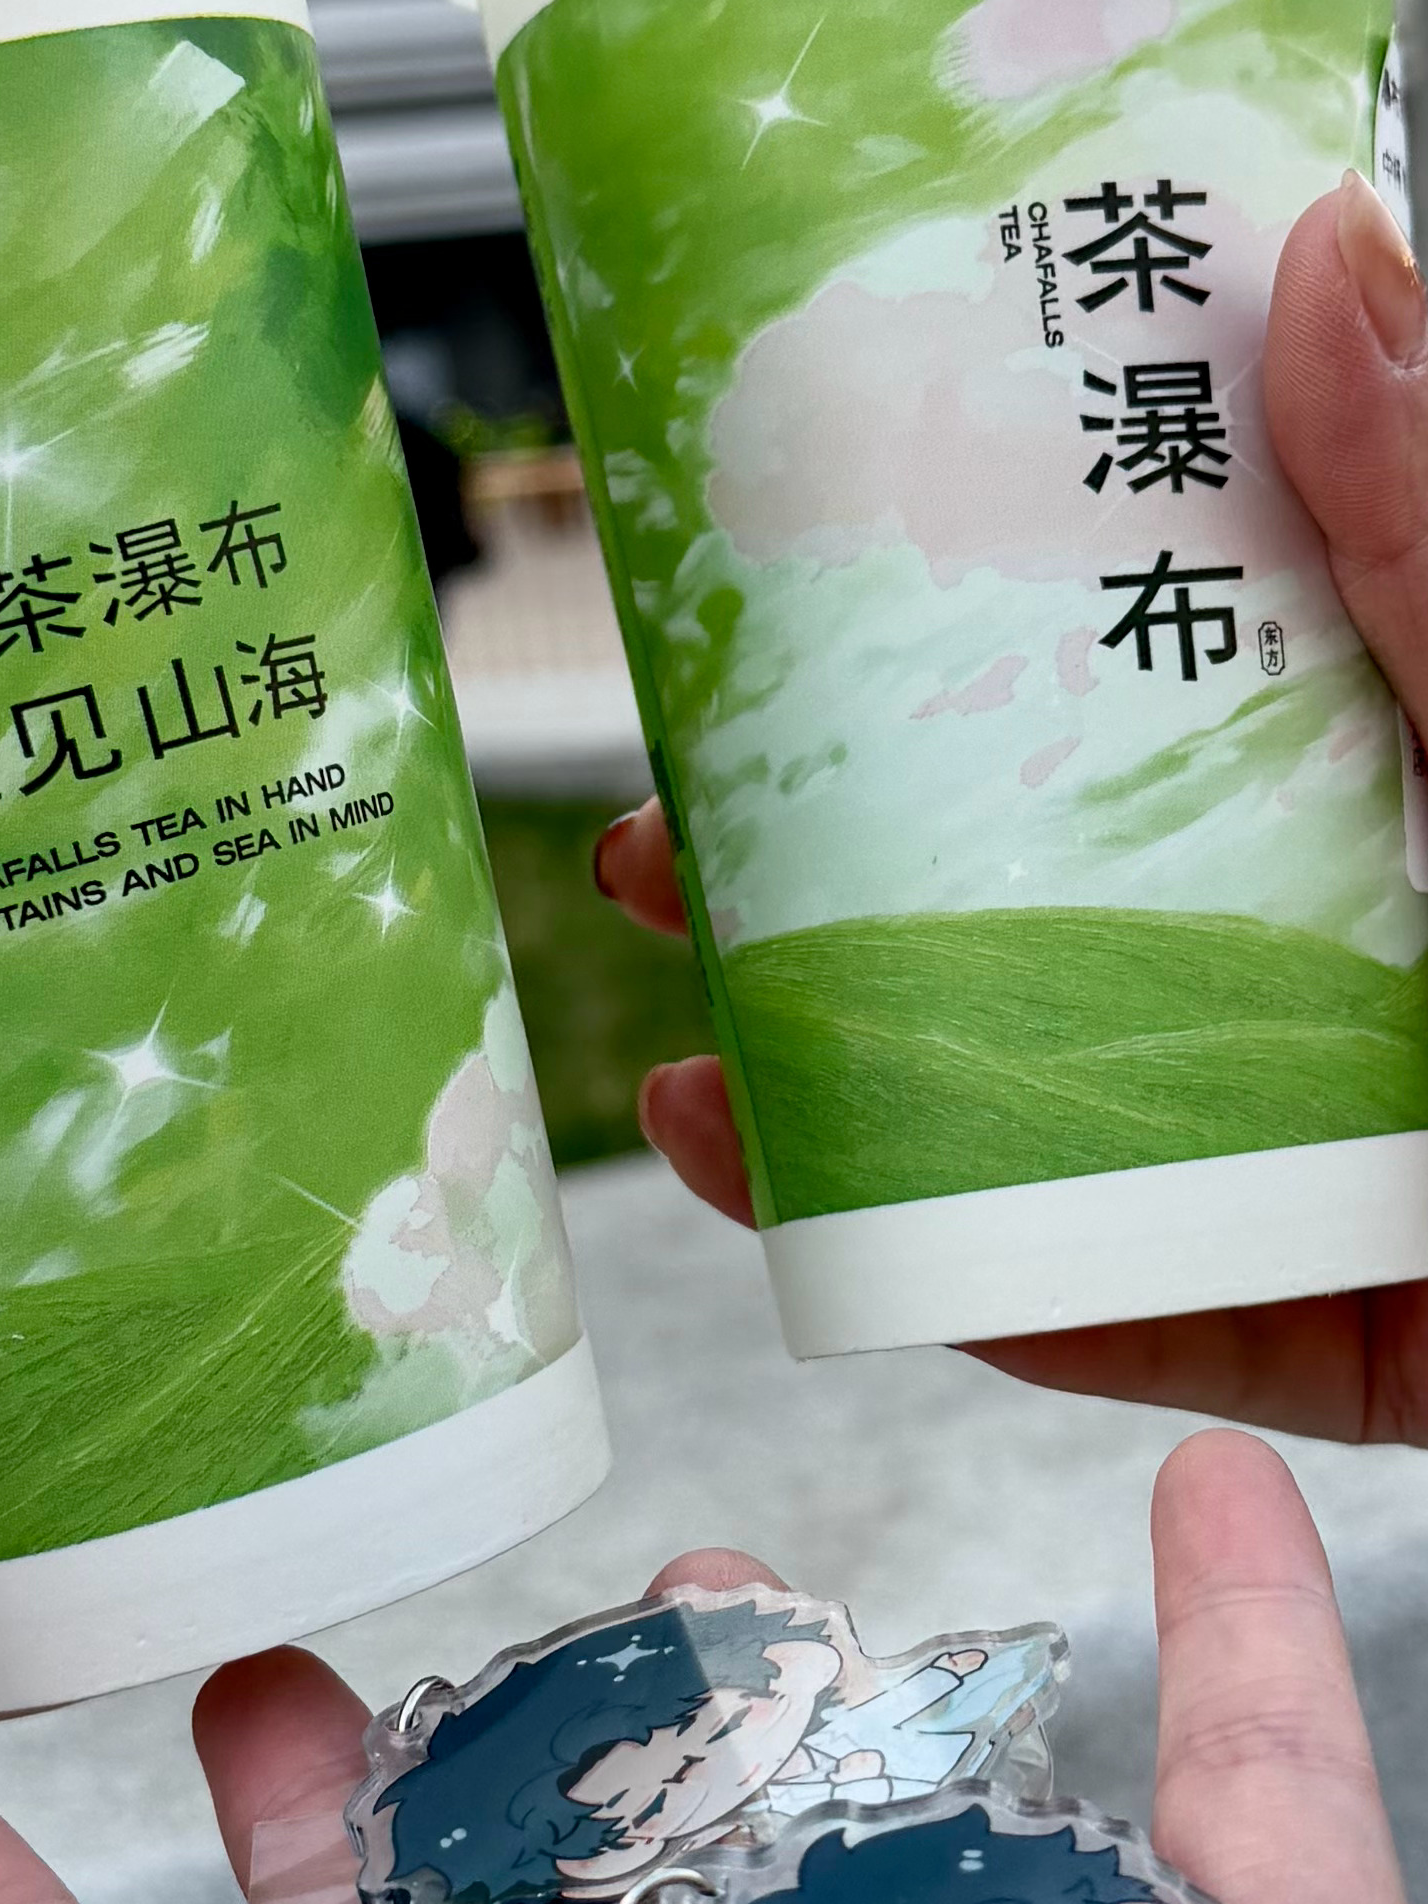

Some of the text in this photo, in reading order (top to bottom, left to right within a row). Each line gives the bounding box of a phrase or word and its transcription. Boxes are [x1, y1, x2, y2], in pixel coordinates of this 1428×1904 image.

[999, 204, 1022, 263] TEA
[1028, 201, 1064, 349] CHAFALLS
[1062, 179, 1244, 682] 茶瀑布
[1263, 627, 1279, 668] 东方
[121, 852, 201, 897] AND
[212, 828, 282, 867] SEA
[288, 812, 321, 845] IN
[329, 791, 395, 833] MIND
[131, 807, 207, 848] TEA
[216, 791, 251, 824] IN
[261, 763, 347, 809] HAND
